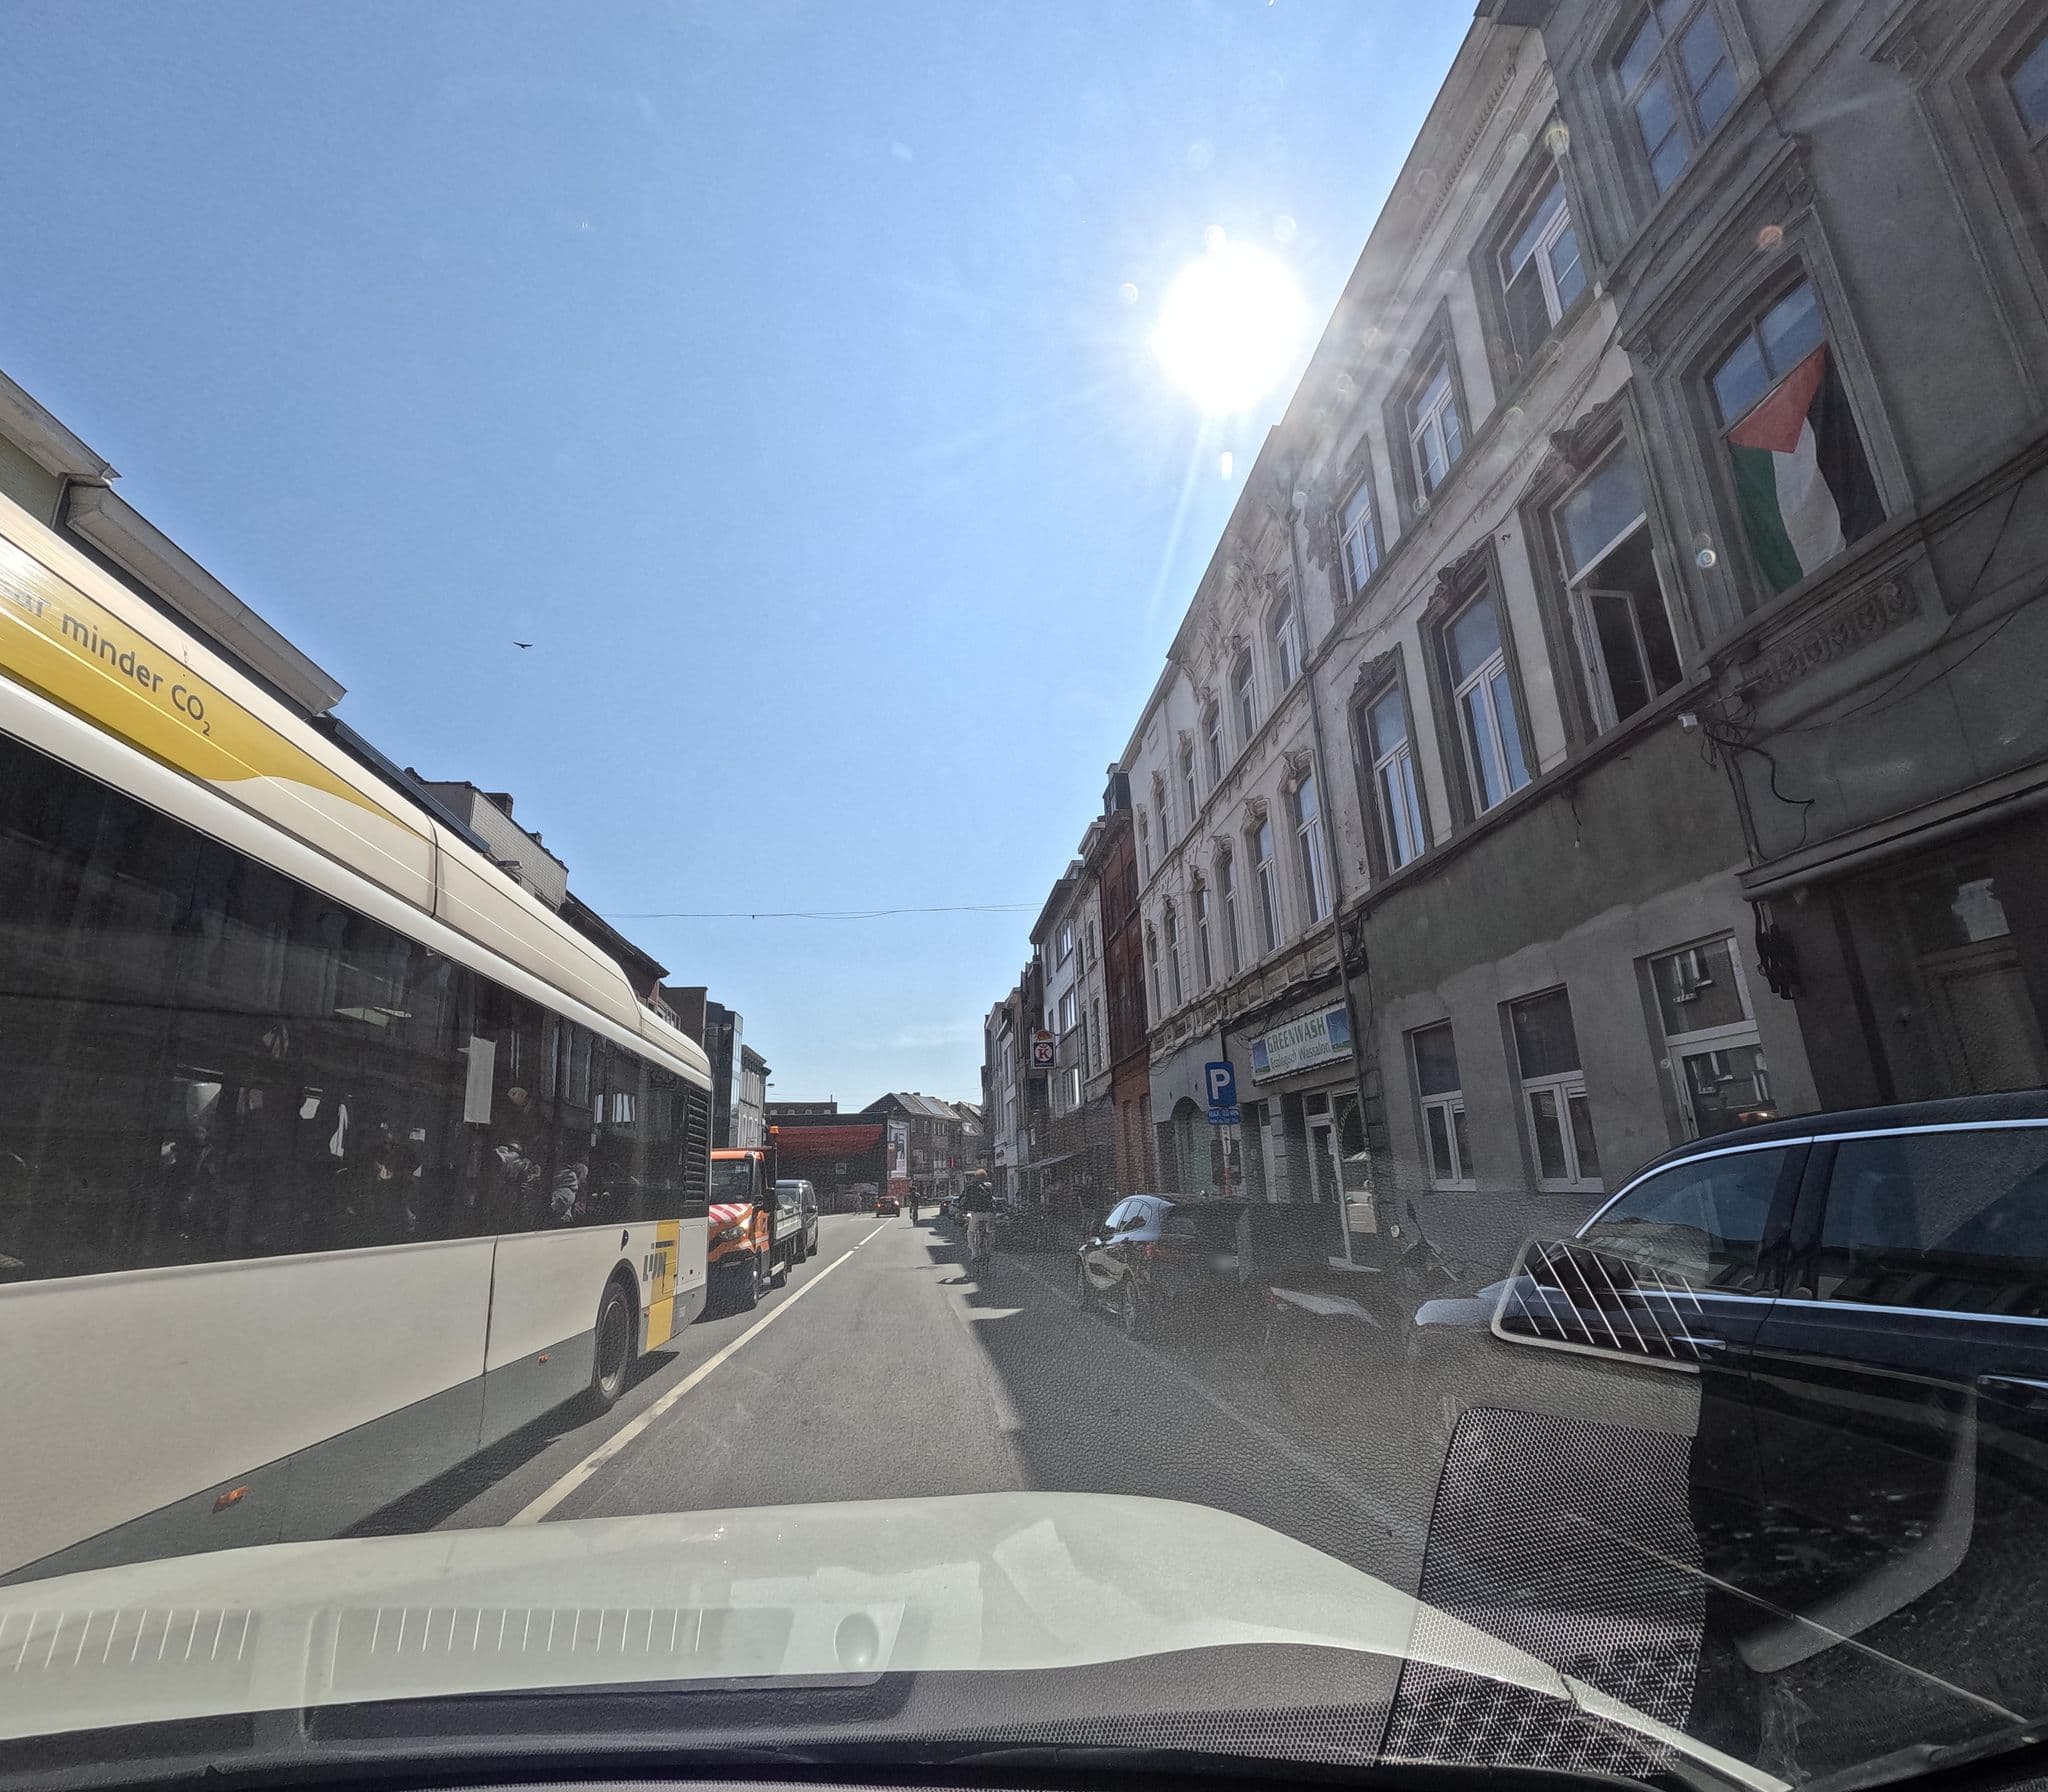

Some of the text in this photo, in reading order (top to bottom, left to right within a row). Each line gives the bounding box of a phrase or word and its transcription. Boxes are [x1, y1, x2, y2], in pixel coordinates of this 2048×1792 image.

[62, 612, 164, 693] minder
[1266, 1016, 1326, 1053] GREENWASH
[1297, 1041, 1331, 1062] Wassalon
[1210, 1068, 1231, 1100] P
